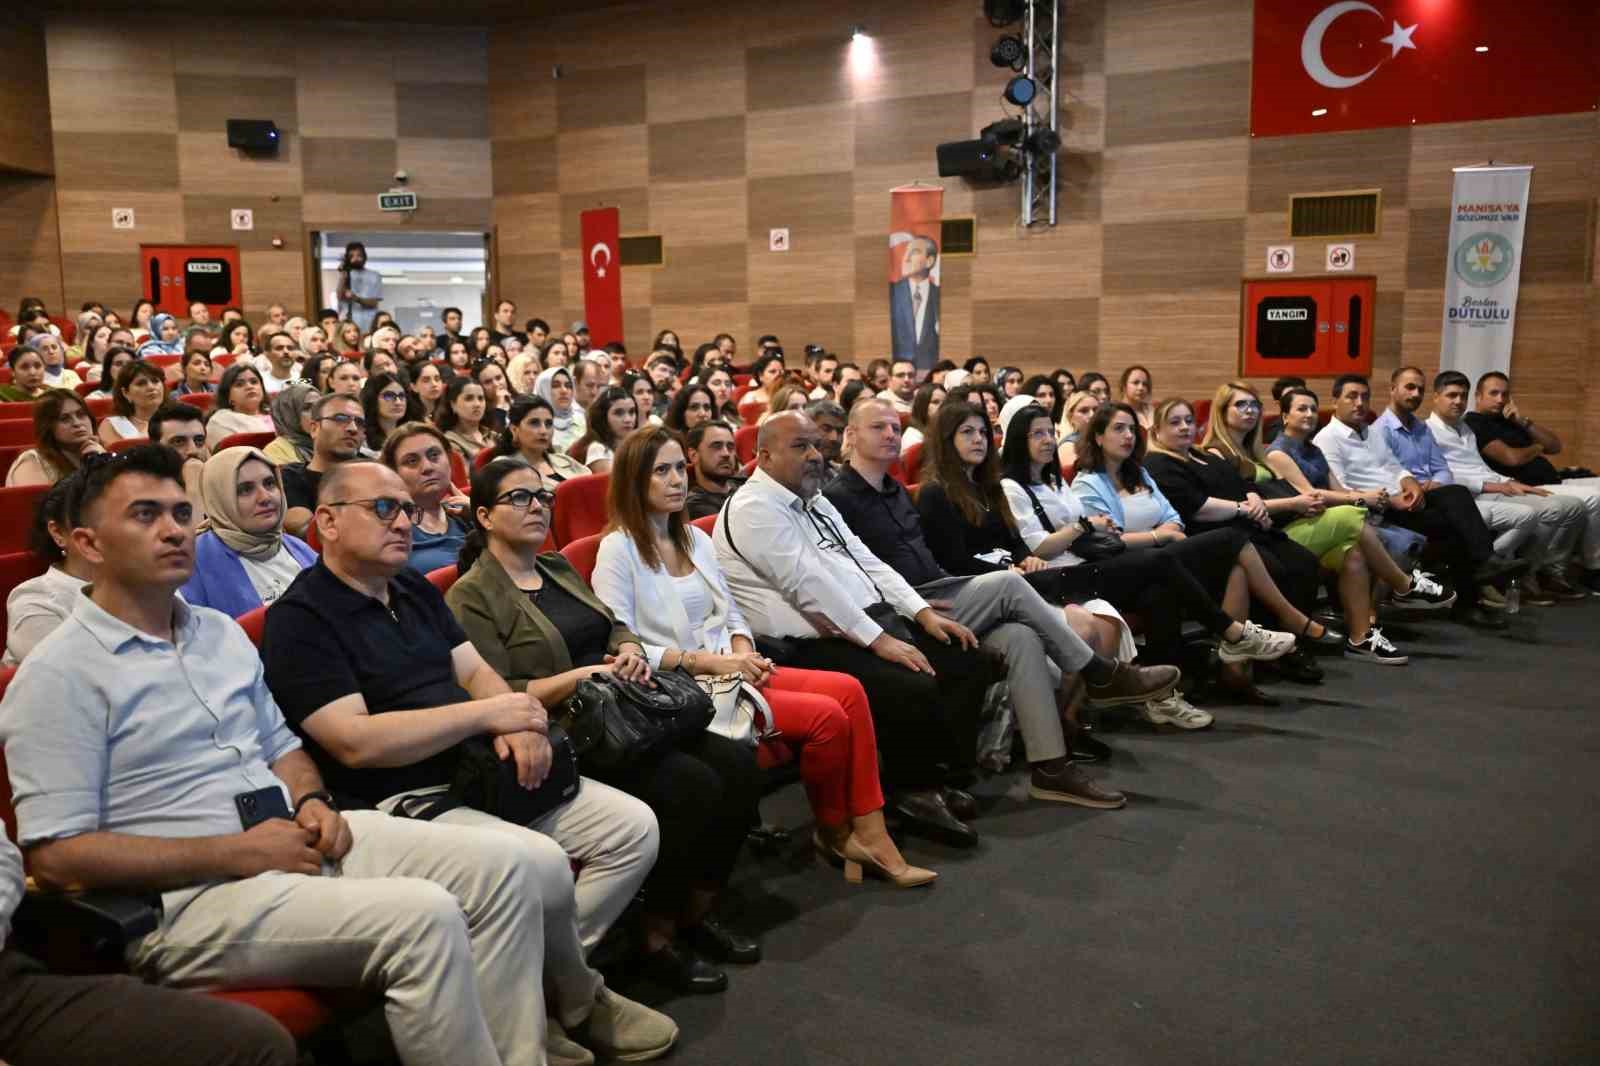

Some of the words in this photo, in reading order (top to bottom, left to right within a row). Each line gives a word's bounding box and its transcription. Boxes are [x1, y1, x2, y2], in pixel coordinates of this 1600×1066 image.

[383, 196, 412, 207] EXIT
[1269, 310, 1305, 319] YANGIN
[1449, 307, 1510, 319] DUTLULU
